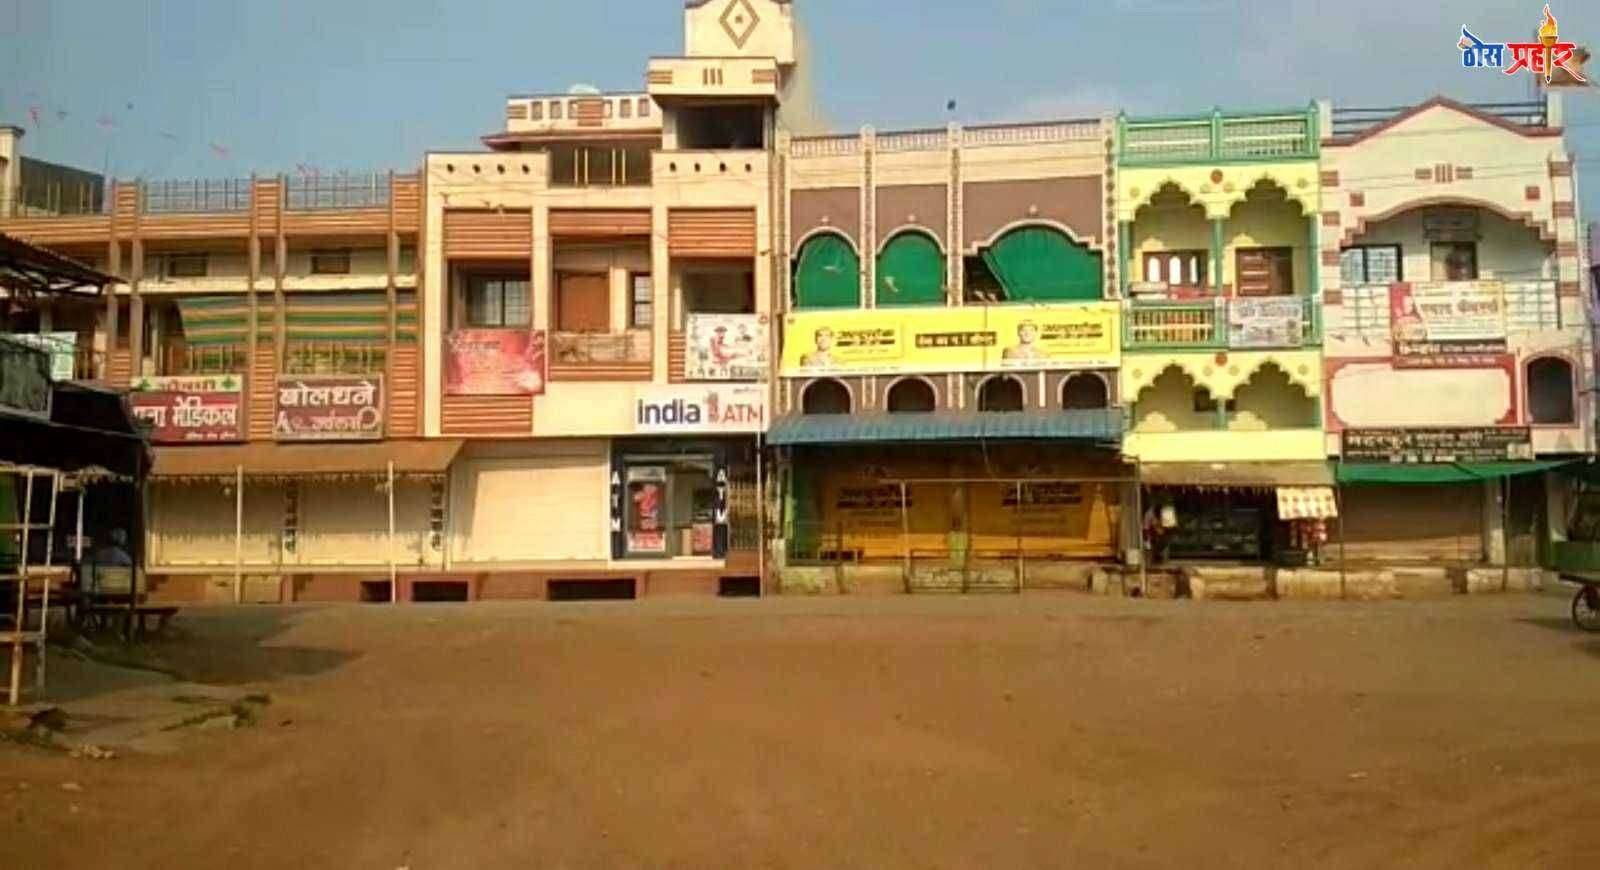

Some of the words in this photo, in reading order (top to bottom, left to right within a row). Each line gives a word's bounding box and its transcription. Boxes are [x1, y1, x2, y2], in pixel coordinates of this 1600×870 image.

[172, 396, 237, 427] मेडिकल
[637, 398, 701, 424] india
[721, 403, 764, 424] ATM
